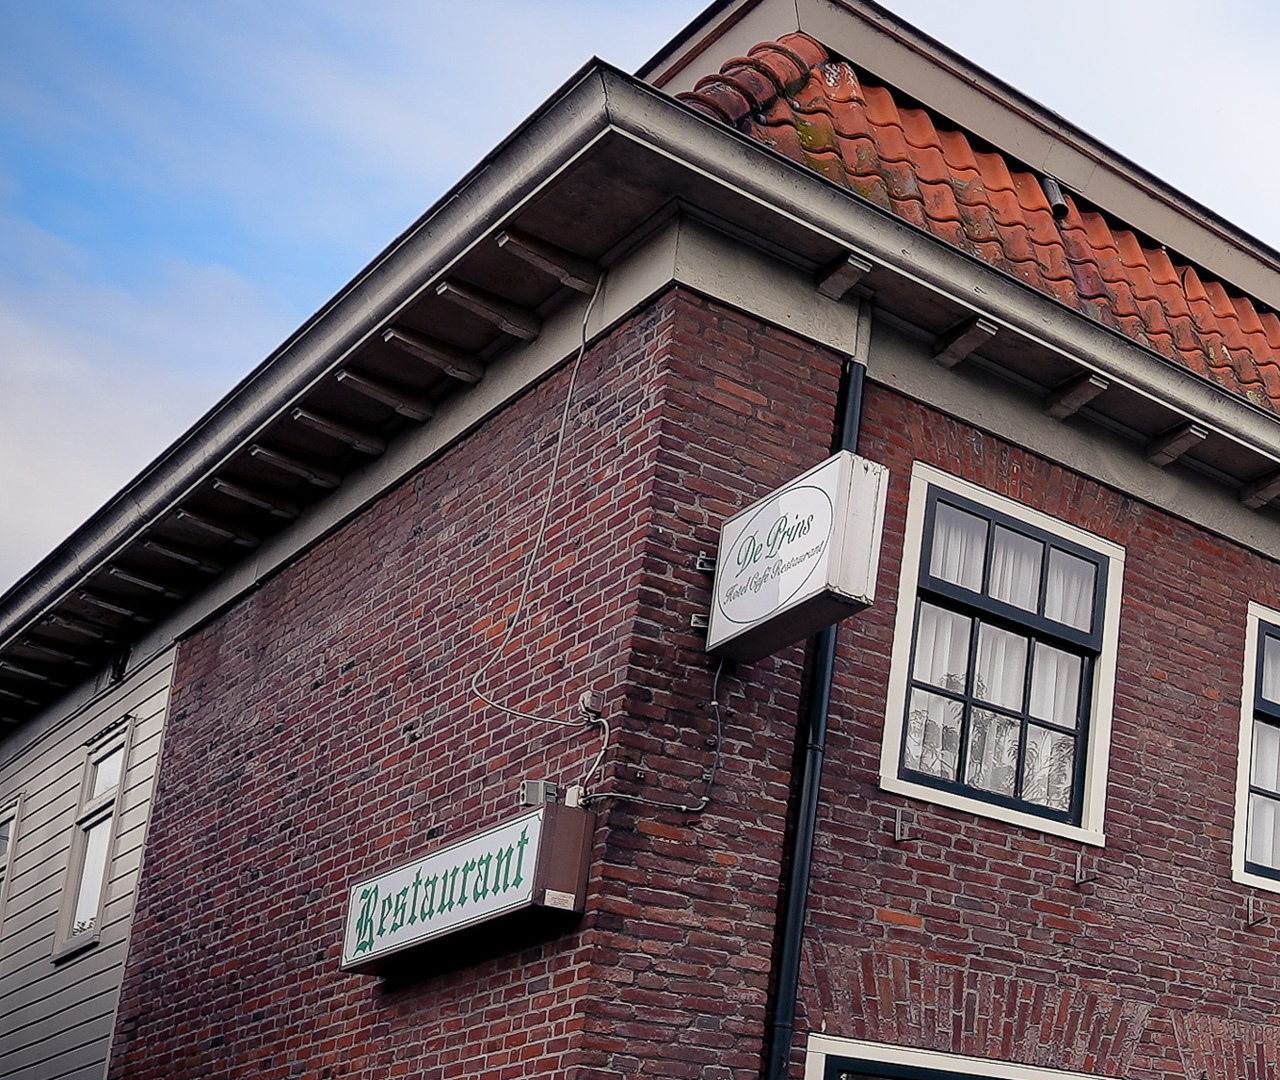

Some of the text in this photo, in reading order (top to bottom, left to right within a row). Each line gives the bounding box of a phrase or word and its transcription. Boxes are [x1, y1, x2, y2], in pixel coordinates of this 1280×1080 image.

[723, 576, 752, 605] Hotel
[771, 540, 825, 580] Restaurant
[735, 512, 814, 578] De Prins
[353, 824, 529, 957] Restaurant
